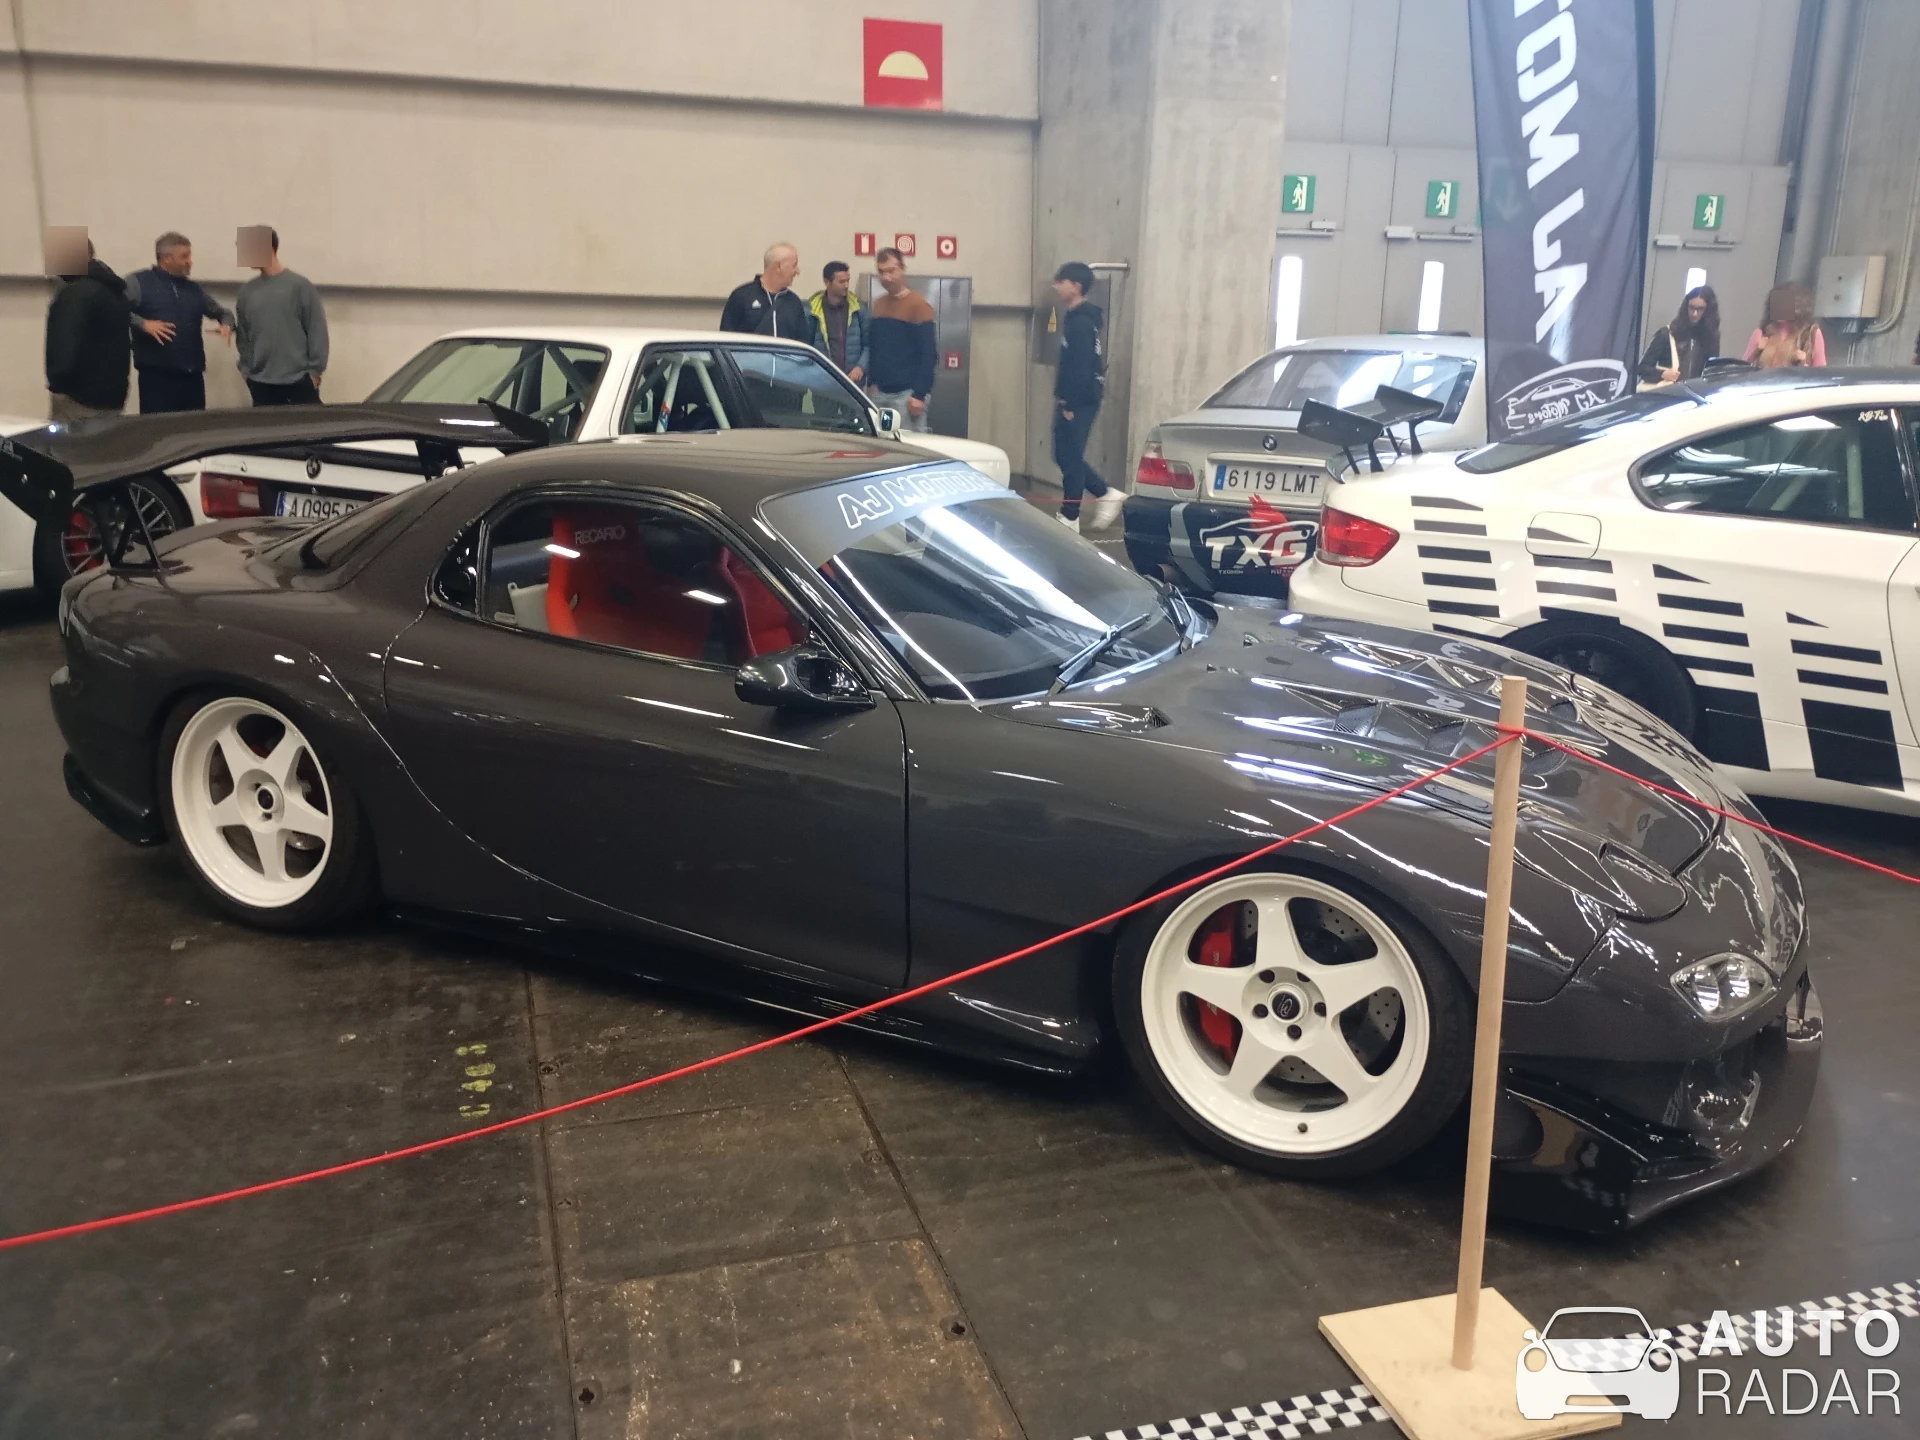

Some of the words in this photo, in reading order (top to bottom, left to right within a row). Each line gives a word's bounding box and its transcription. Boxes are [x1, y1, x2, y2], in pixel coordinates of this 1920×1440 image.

[1228, 469, 1276, 490] 6119
[1281, 474, 1320, 494] LMT
[289, 496, 298, 518] A
[837, 484, 894, 530] AJ
[574, 525, 626, 545] RECARO
[1205, 529, 1310, 569] TXG
